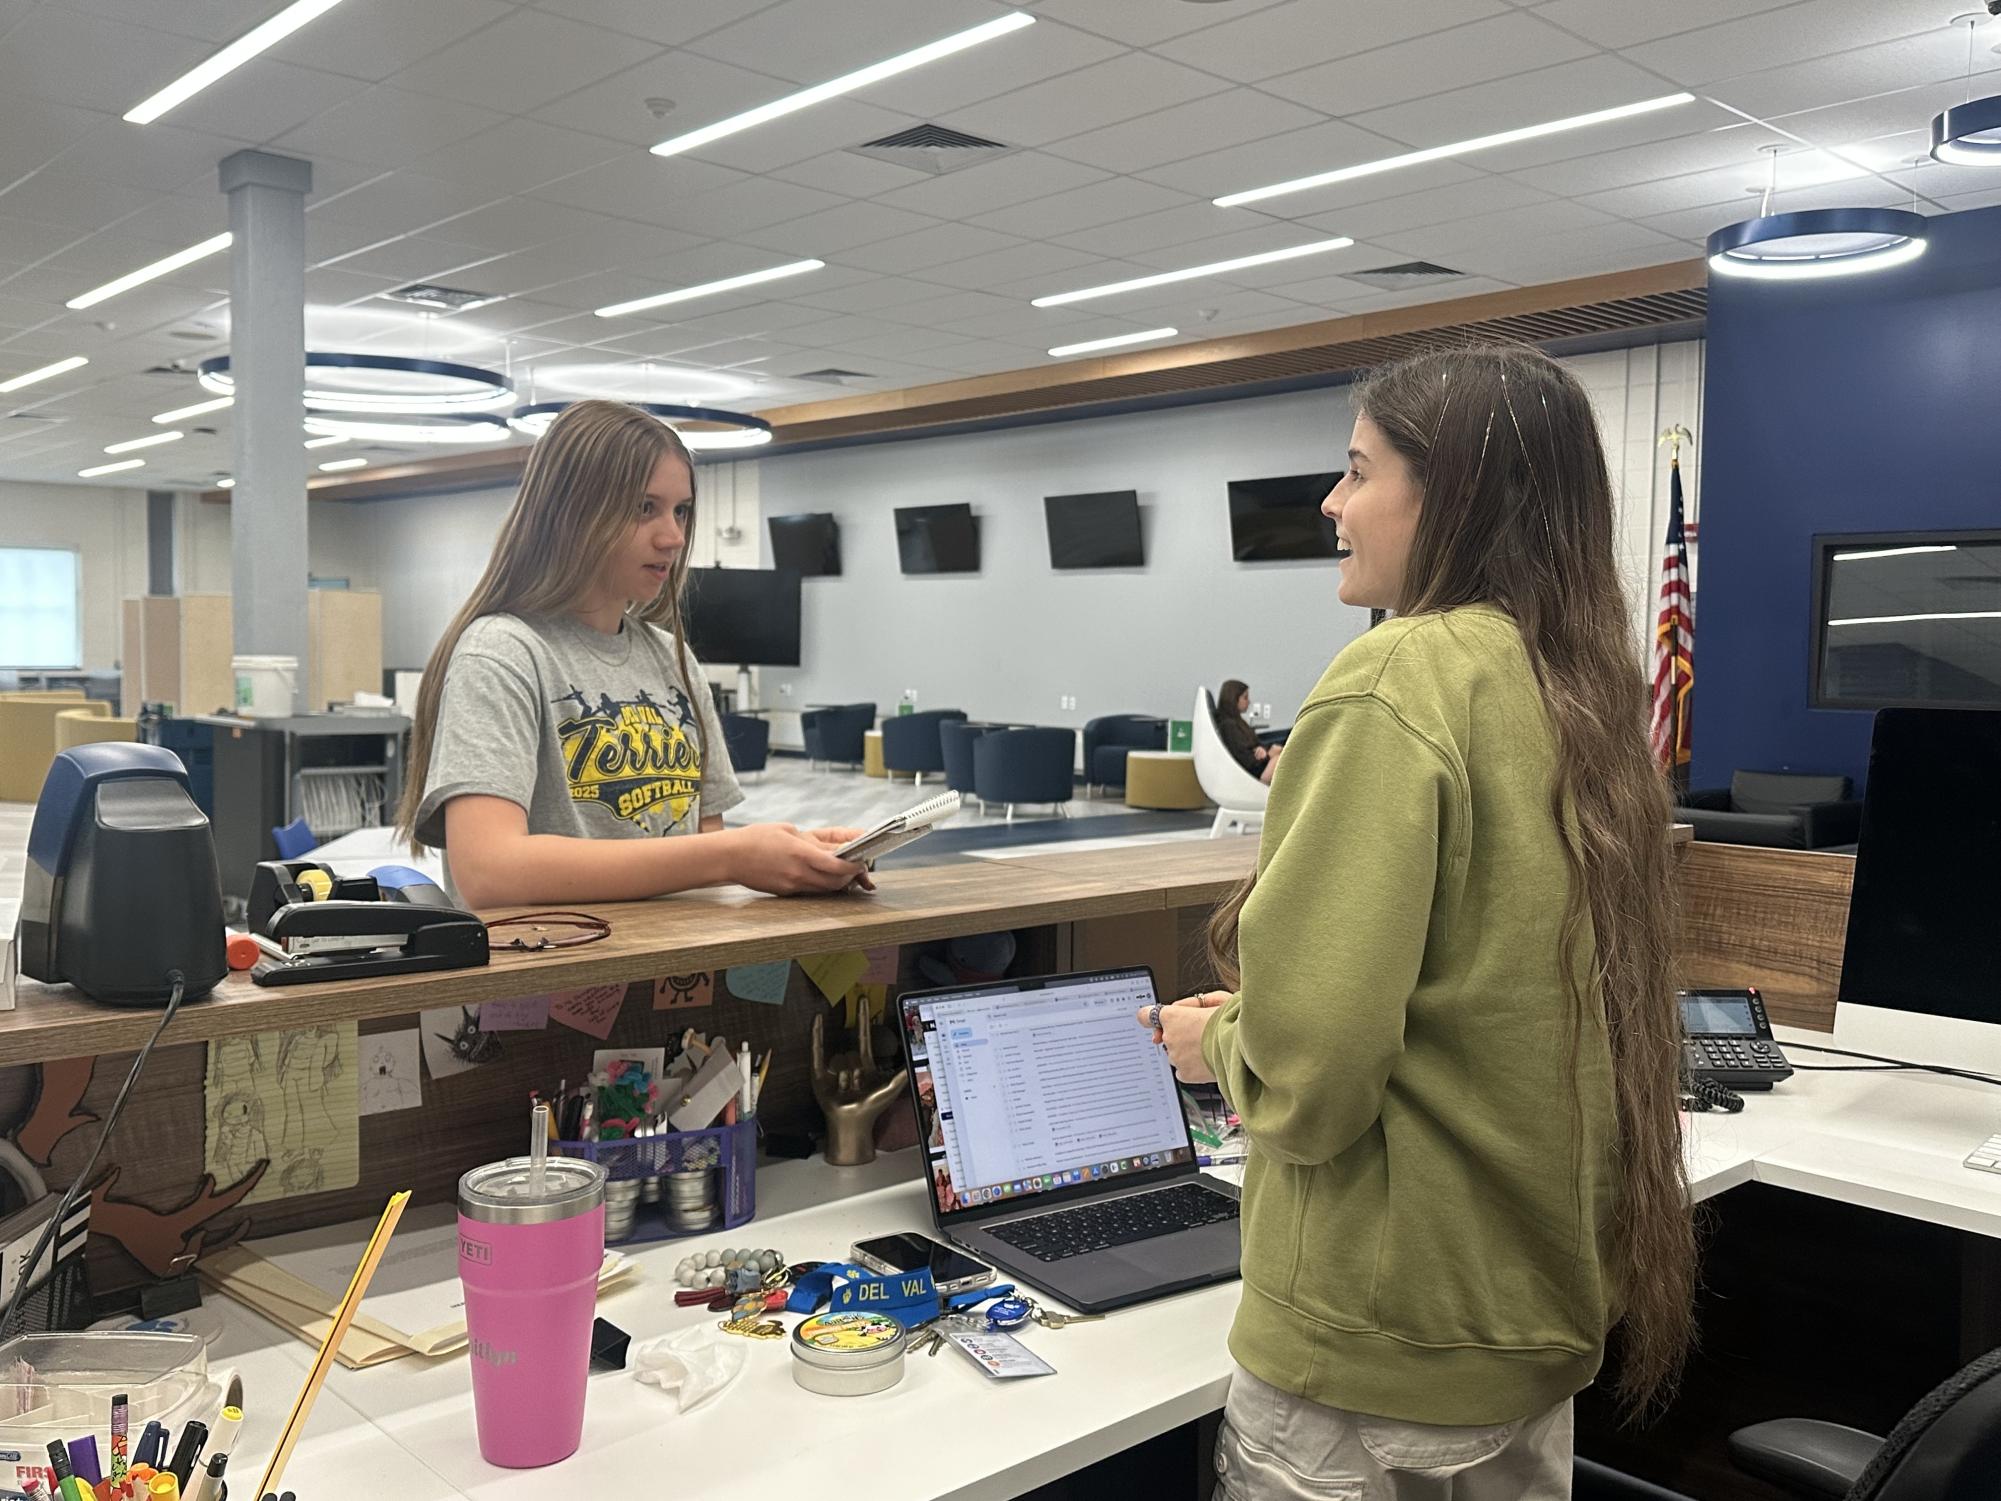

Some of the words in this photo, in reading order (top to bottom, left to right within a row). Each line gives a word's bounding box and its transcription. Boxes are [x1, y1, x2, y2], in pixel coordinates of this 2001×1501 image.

[618, 779, 694, 816] SOFTBALL
[460, 1237, 489, 1261] YETI
[859, 1282, 890, 1301] DEL
[901, 1278, 927, 1298] VAL
